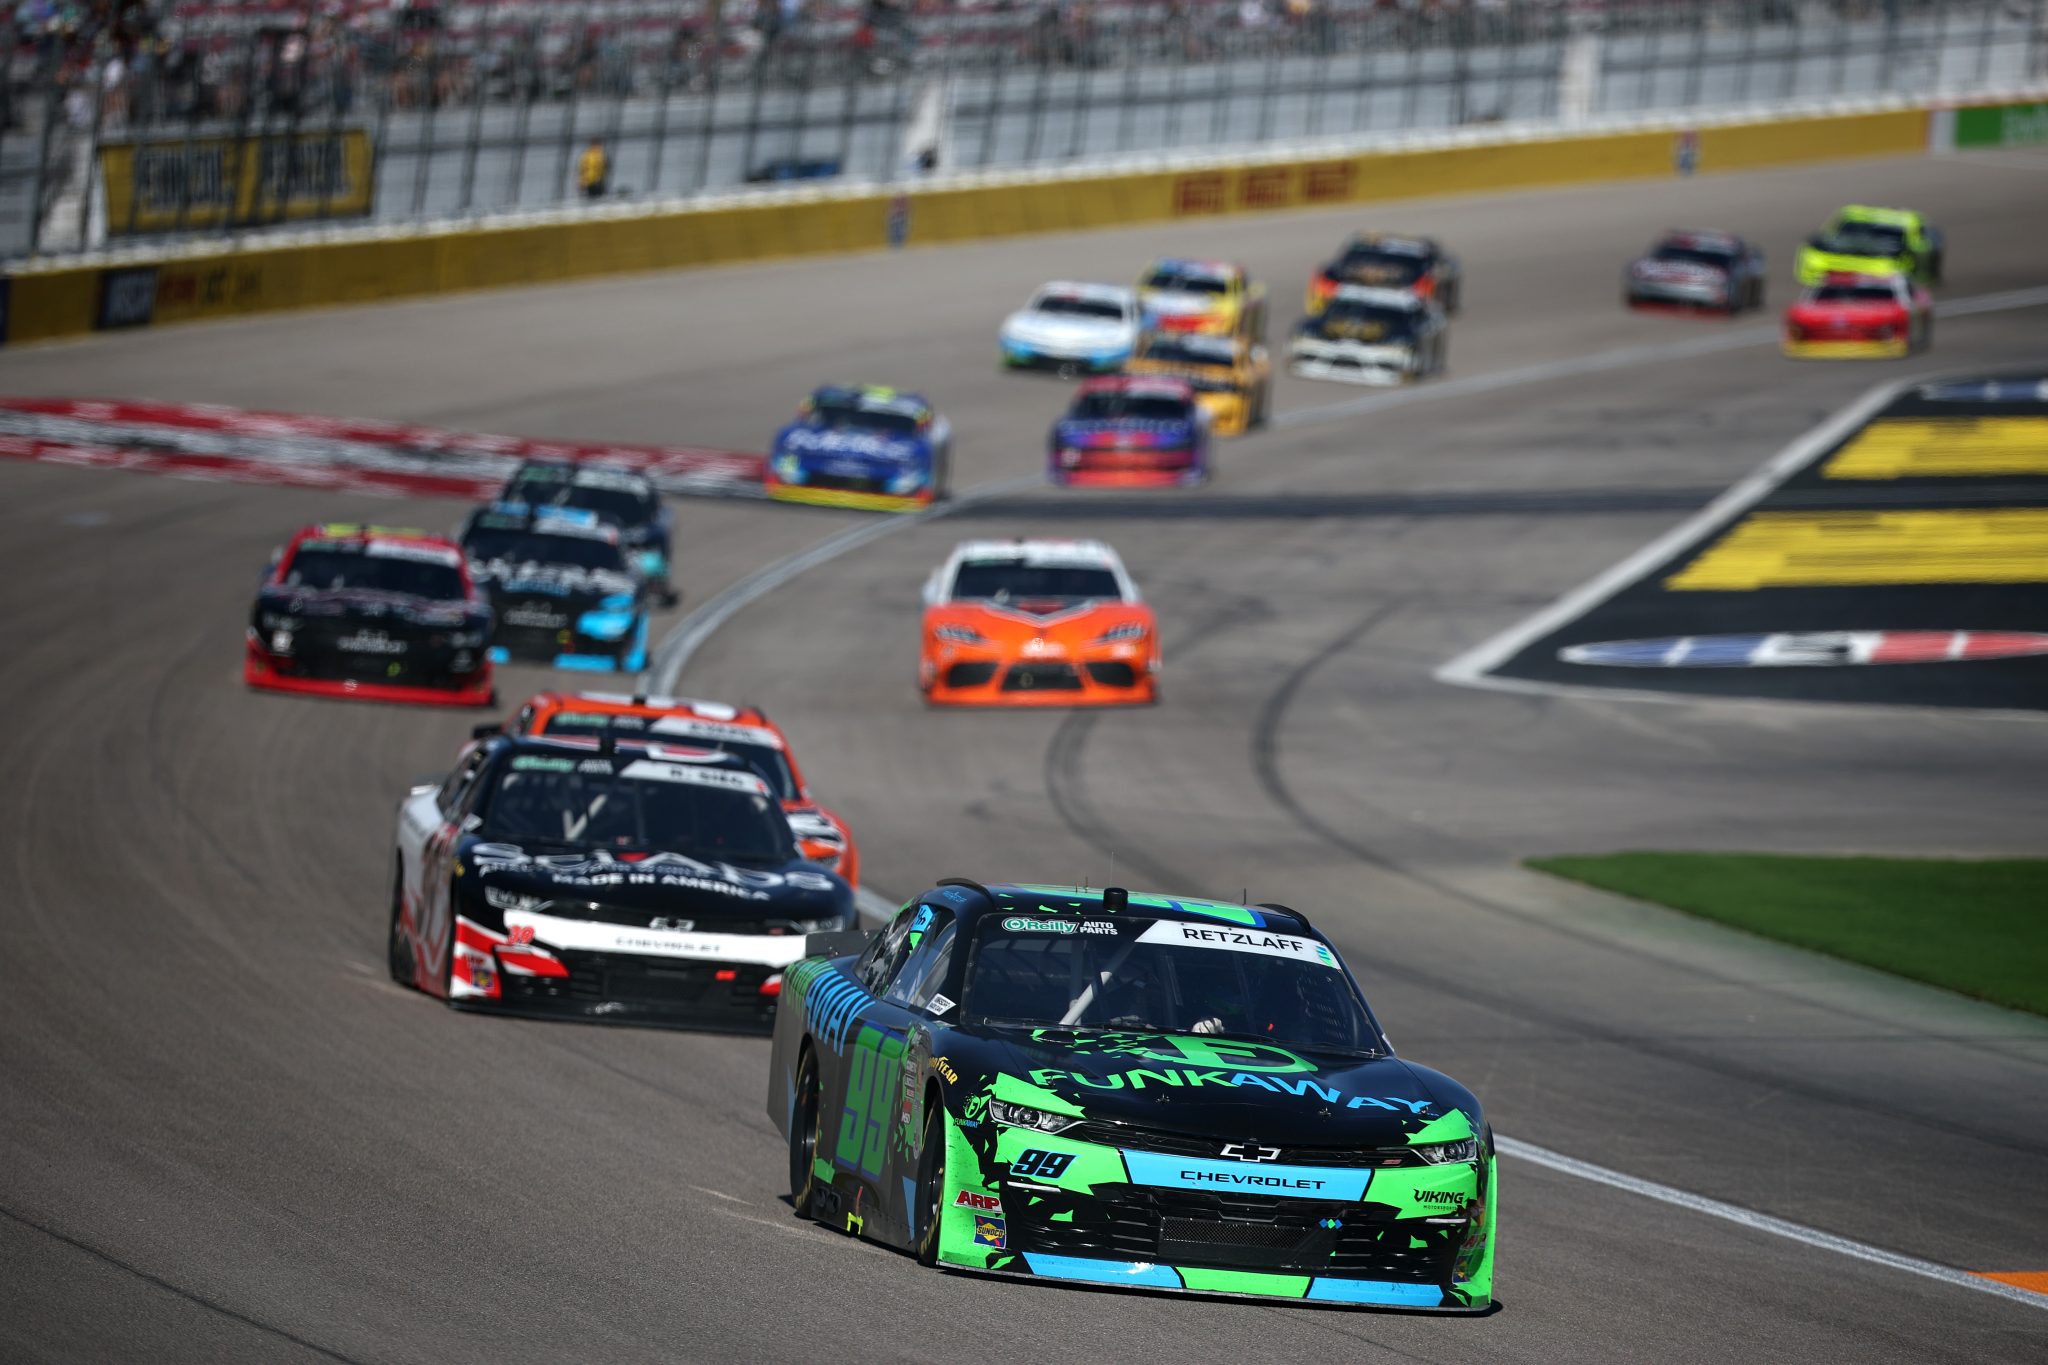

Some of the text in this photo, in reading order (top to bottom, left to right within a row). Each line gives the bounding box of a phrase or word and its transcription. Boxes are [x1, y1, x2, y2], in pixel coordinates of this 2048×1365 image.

[552, 873, 770, 901] MADE IN AMERICA
[1003, 918, 1078, 933] O'Reilly
[1080, 927, 1118, 935] PARTS
[1083, 921, 1114, 929] AUTO
[1183, 928, 1304, 952] RETZLAFF
[835, 1020, 909, 1182] 99
[1028, 1067, 1434, 1115] FUNKAWAY
[1010, 1149, 1077, 1180] 99
[1180, 1170, 1326, 1190] CHEVROLET
[956, 1190, 1001, 1210] ARP
[1413, 1188, 1465, 1204] VIKING
[977, 1225, 1004, 1239] SUNOCO
